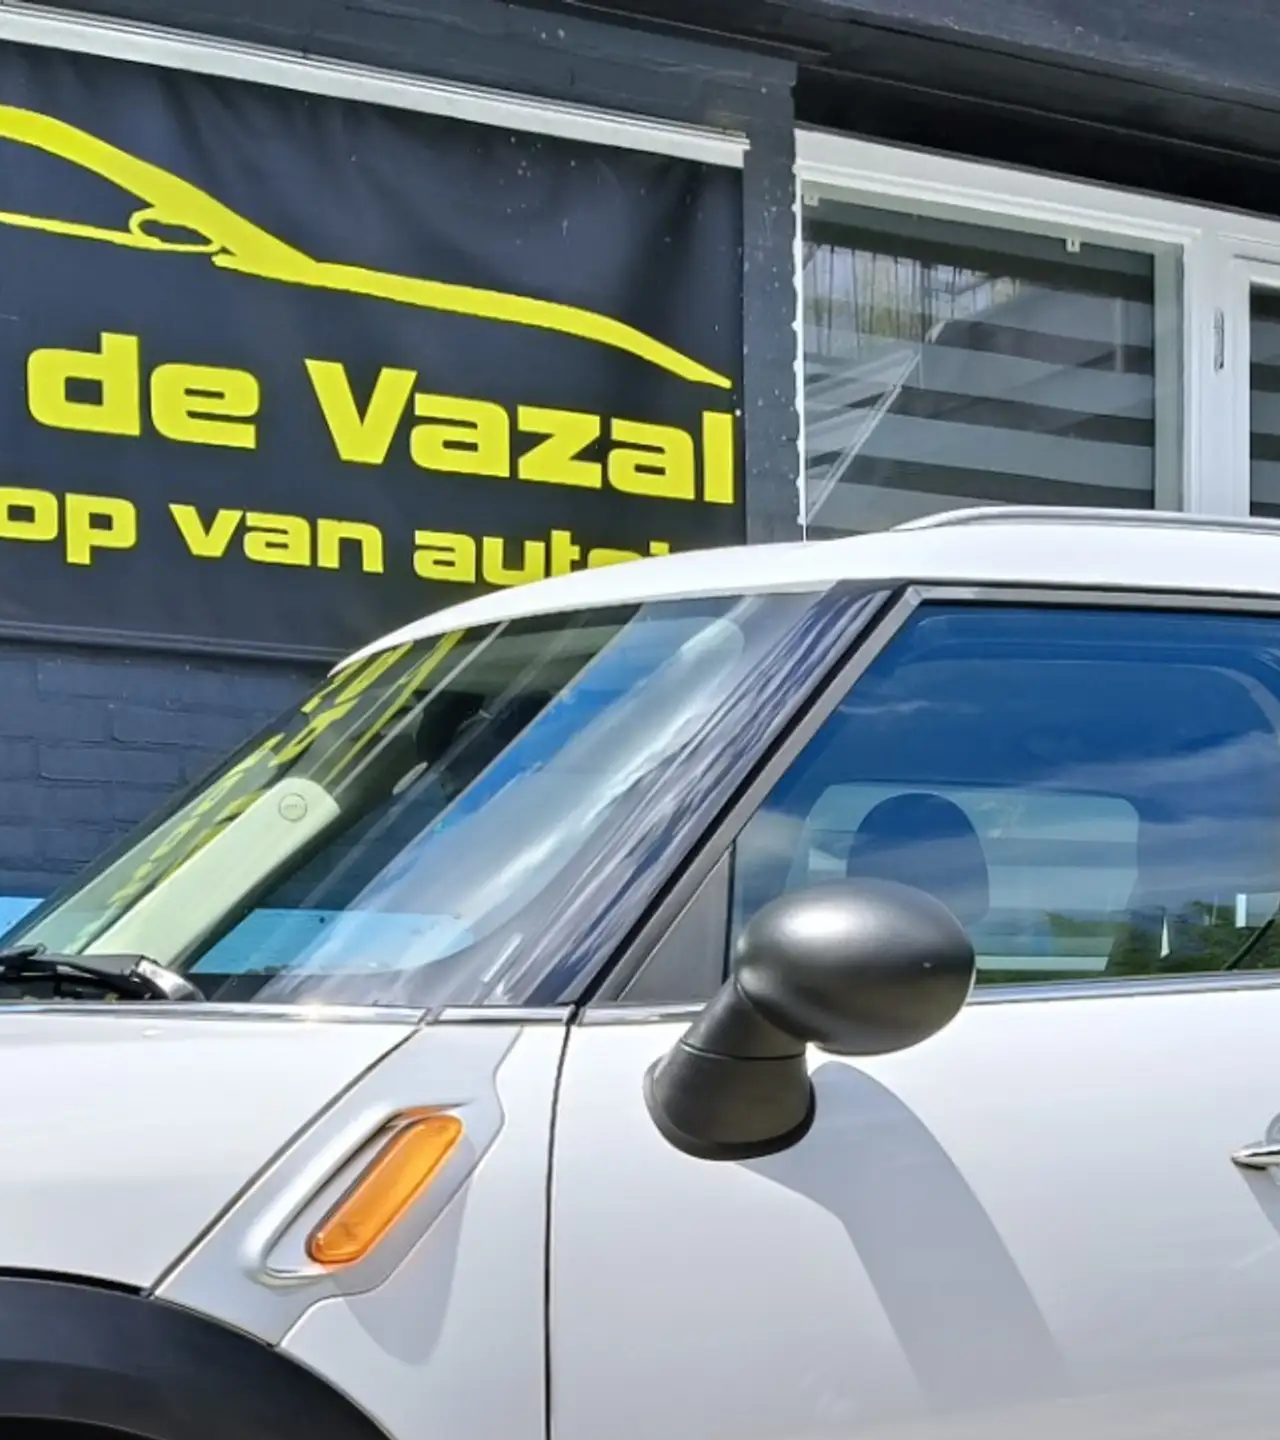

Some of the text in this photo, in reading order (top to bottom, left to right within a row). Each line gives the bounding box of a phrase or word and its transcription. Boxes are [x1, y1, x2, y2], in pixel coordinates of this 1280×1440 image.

[26, 331, 261, 450] de
[304, 357, 735, 505] Vazal
[169, 503, 385, 574] van
